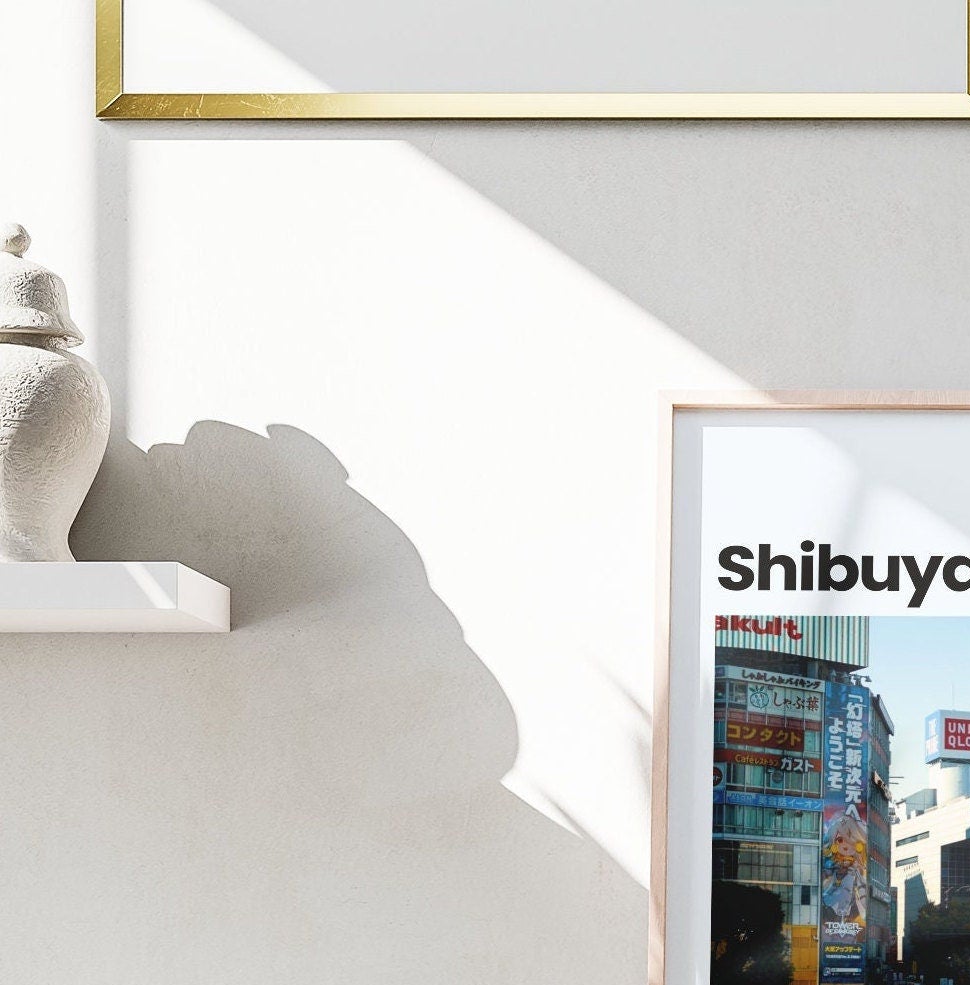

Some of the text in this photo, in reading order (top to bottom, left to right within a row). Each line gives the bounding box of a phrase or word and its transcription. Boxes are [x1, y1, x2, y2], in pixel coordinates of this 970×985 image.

[772, 692, 820, 712] しゃぶ葉
[727, 724, 801, 747] コンタクト
[948, 722, 970, 734] UNI
[828, 716, 845, 791] ようこそ
[780, 757, 815, 772] ガスト
